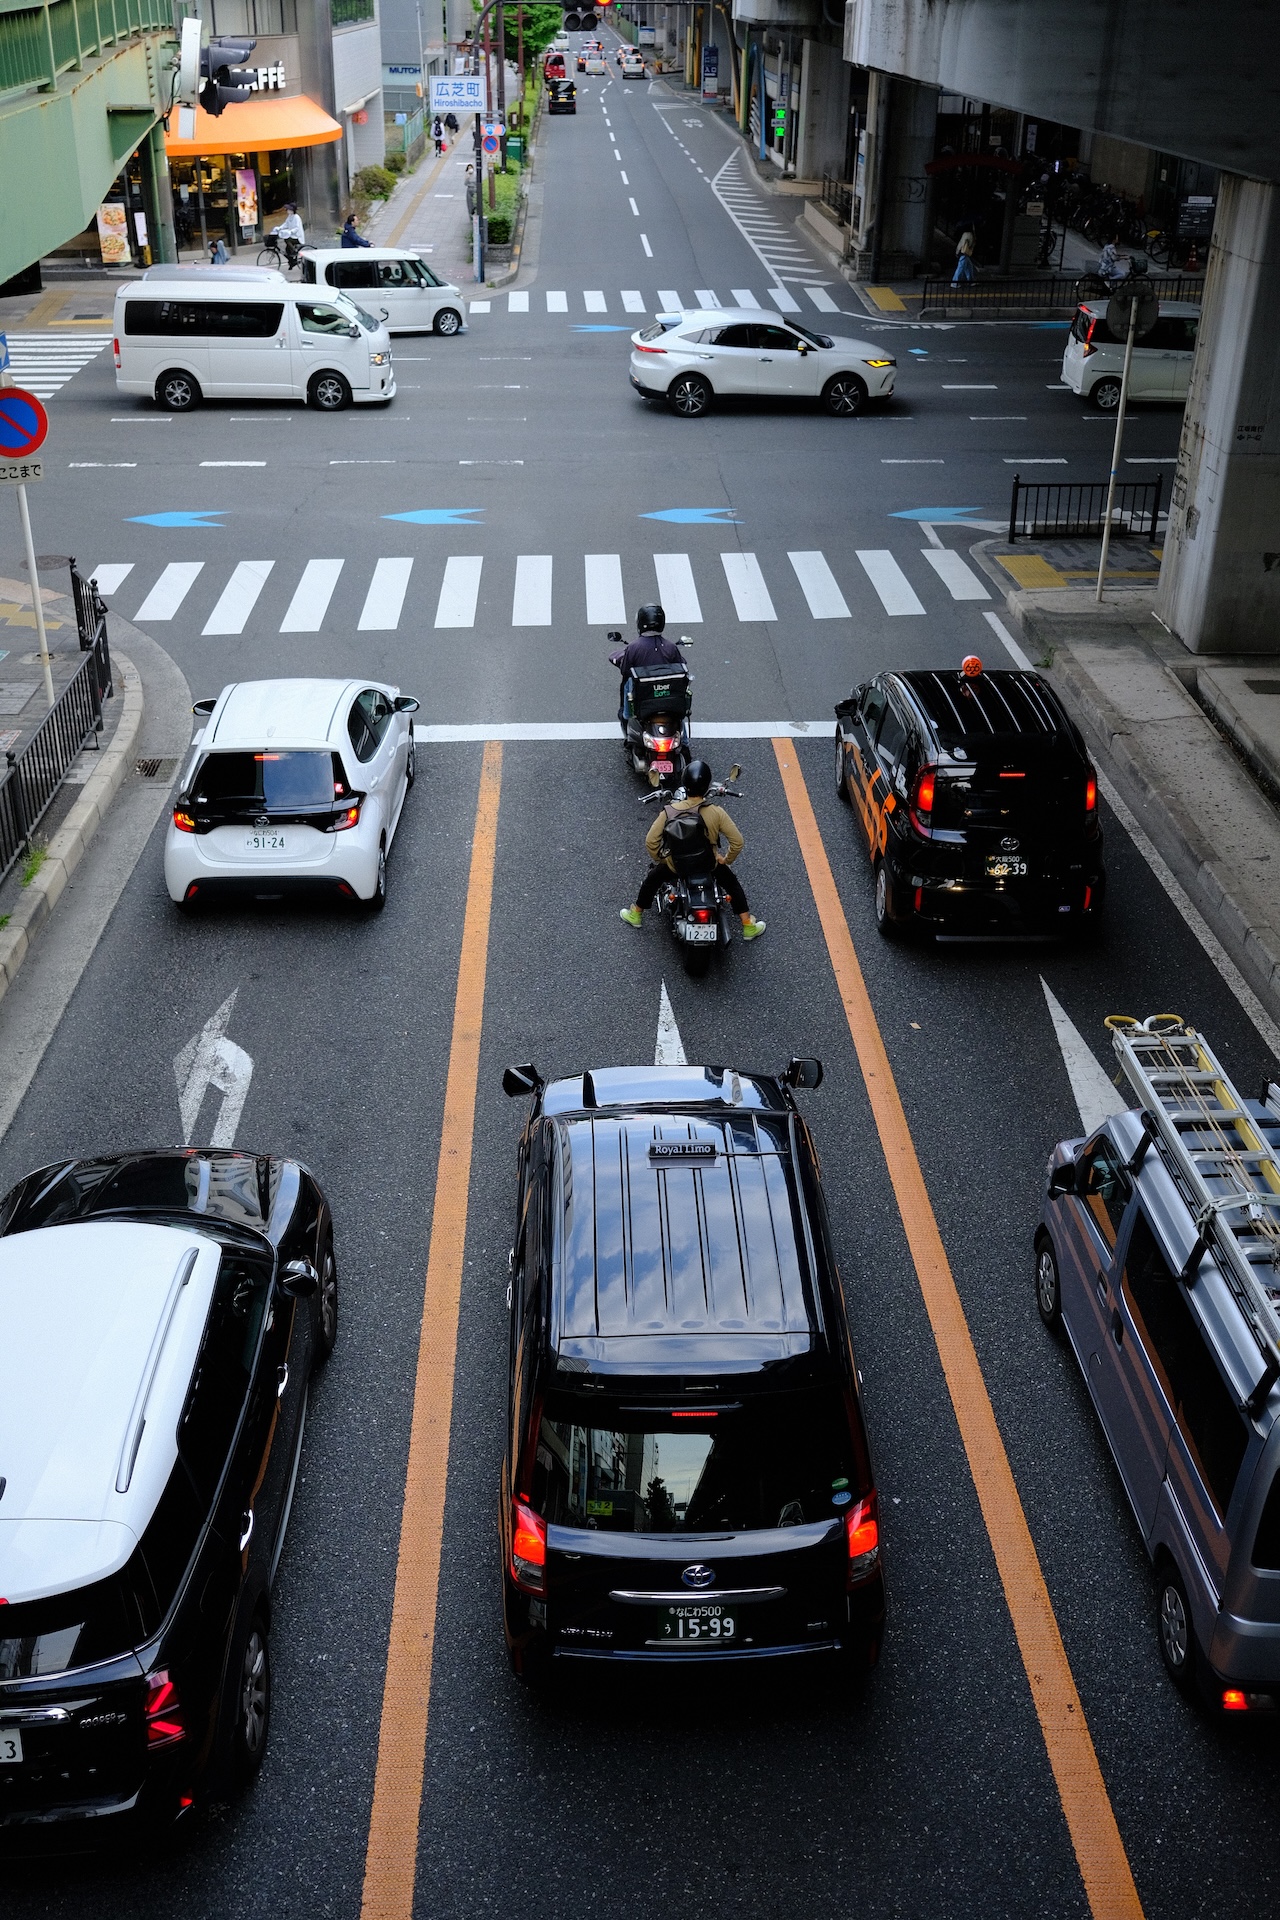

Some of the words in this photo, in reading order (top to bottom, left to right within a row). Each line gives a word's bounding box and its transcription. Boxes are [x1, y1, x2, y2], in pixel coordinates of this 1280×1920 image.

[436, 82, 480, 97] 広芝町
[434, 99, 483, 107] Hiroshibacho
[0, 464, 41, 479] ここまで
[653, 690, 671, 698] Eats
[253, 837, 285, 849] 91-24
[994, 862, 1027, 875] 62-39
[689, 930, 715, 939] 12-20
[655, 1144, 683, 1155] Royal
[685, 1144, 711, 1153] Limo
[676, 1606, 722, 1617] なにわ500
[664, 1623, 671, 1634] う
[678, 1617, 735, 1638] 15-99
[0, 1740, 17, 1759] 3
